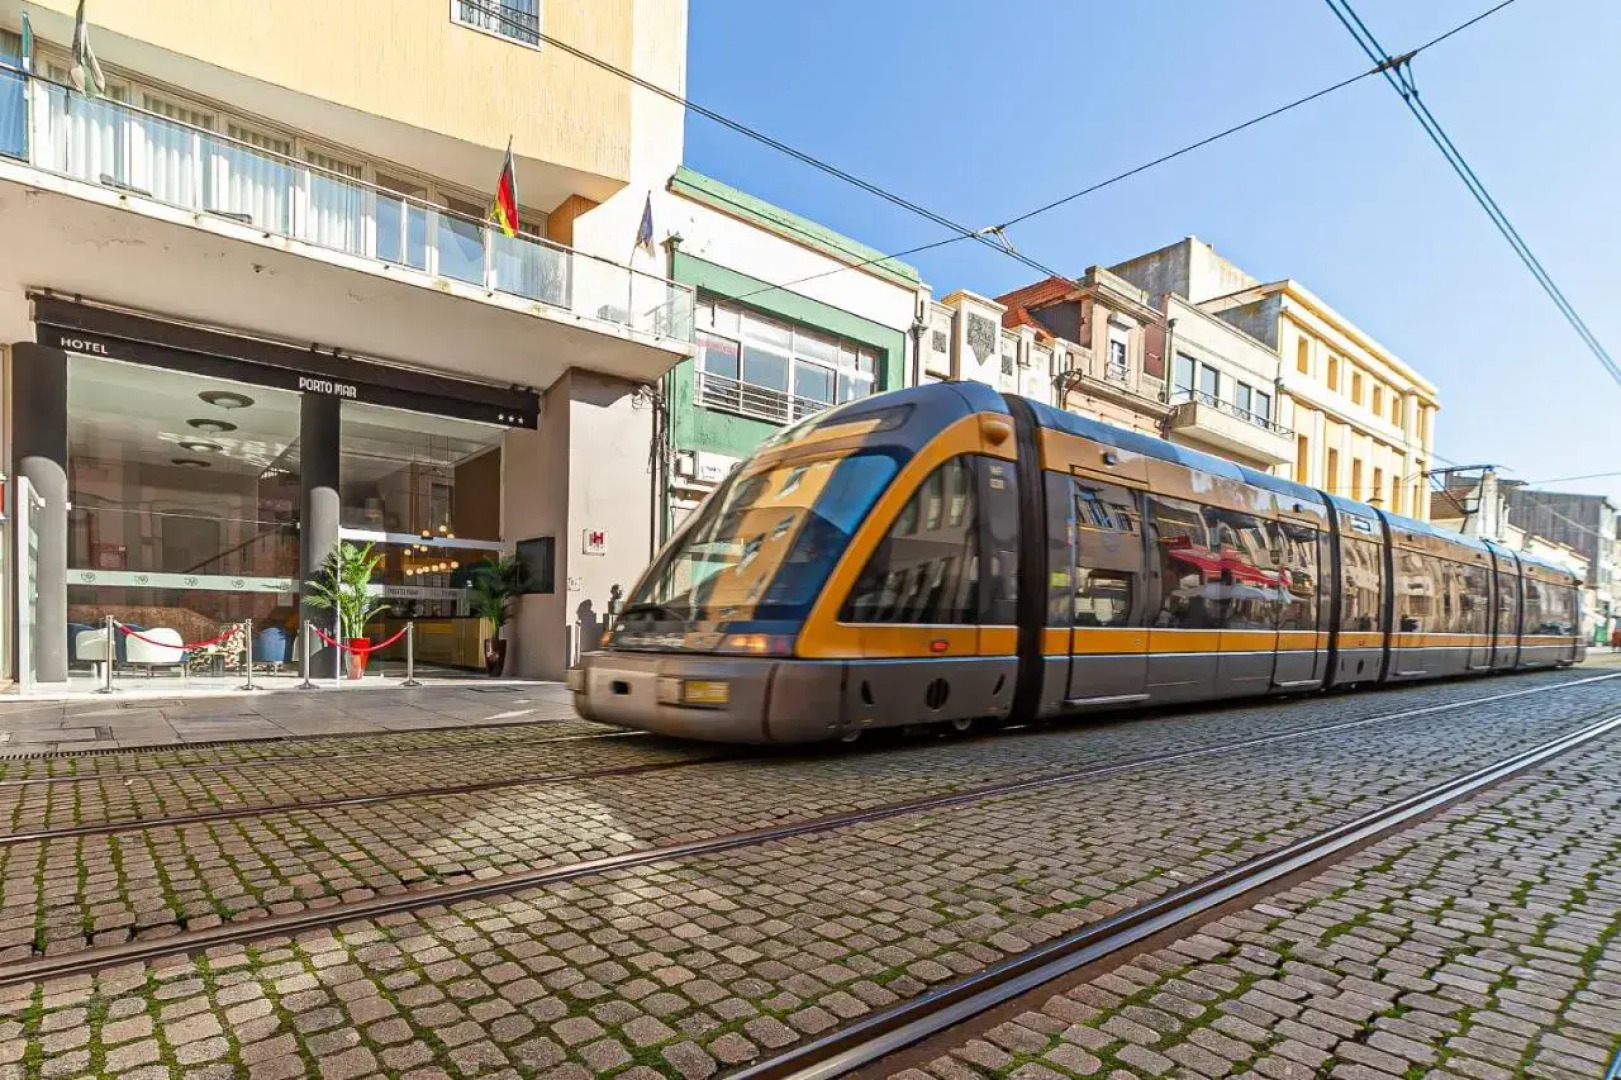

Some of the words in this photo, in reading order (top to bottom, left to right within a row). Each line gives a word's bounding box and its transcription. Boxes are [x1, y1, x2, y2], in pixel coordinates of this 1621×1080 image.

[61, 337, 108, 354] HOTEL
[299, 376, 333, 394] PORTO
[334, 383, 357, 398] MAR
[593, 531, 604, 544] H
